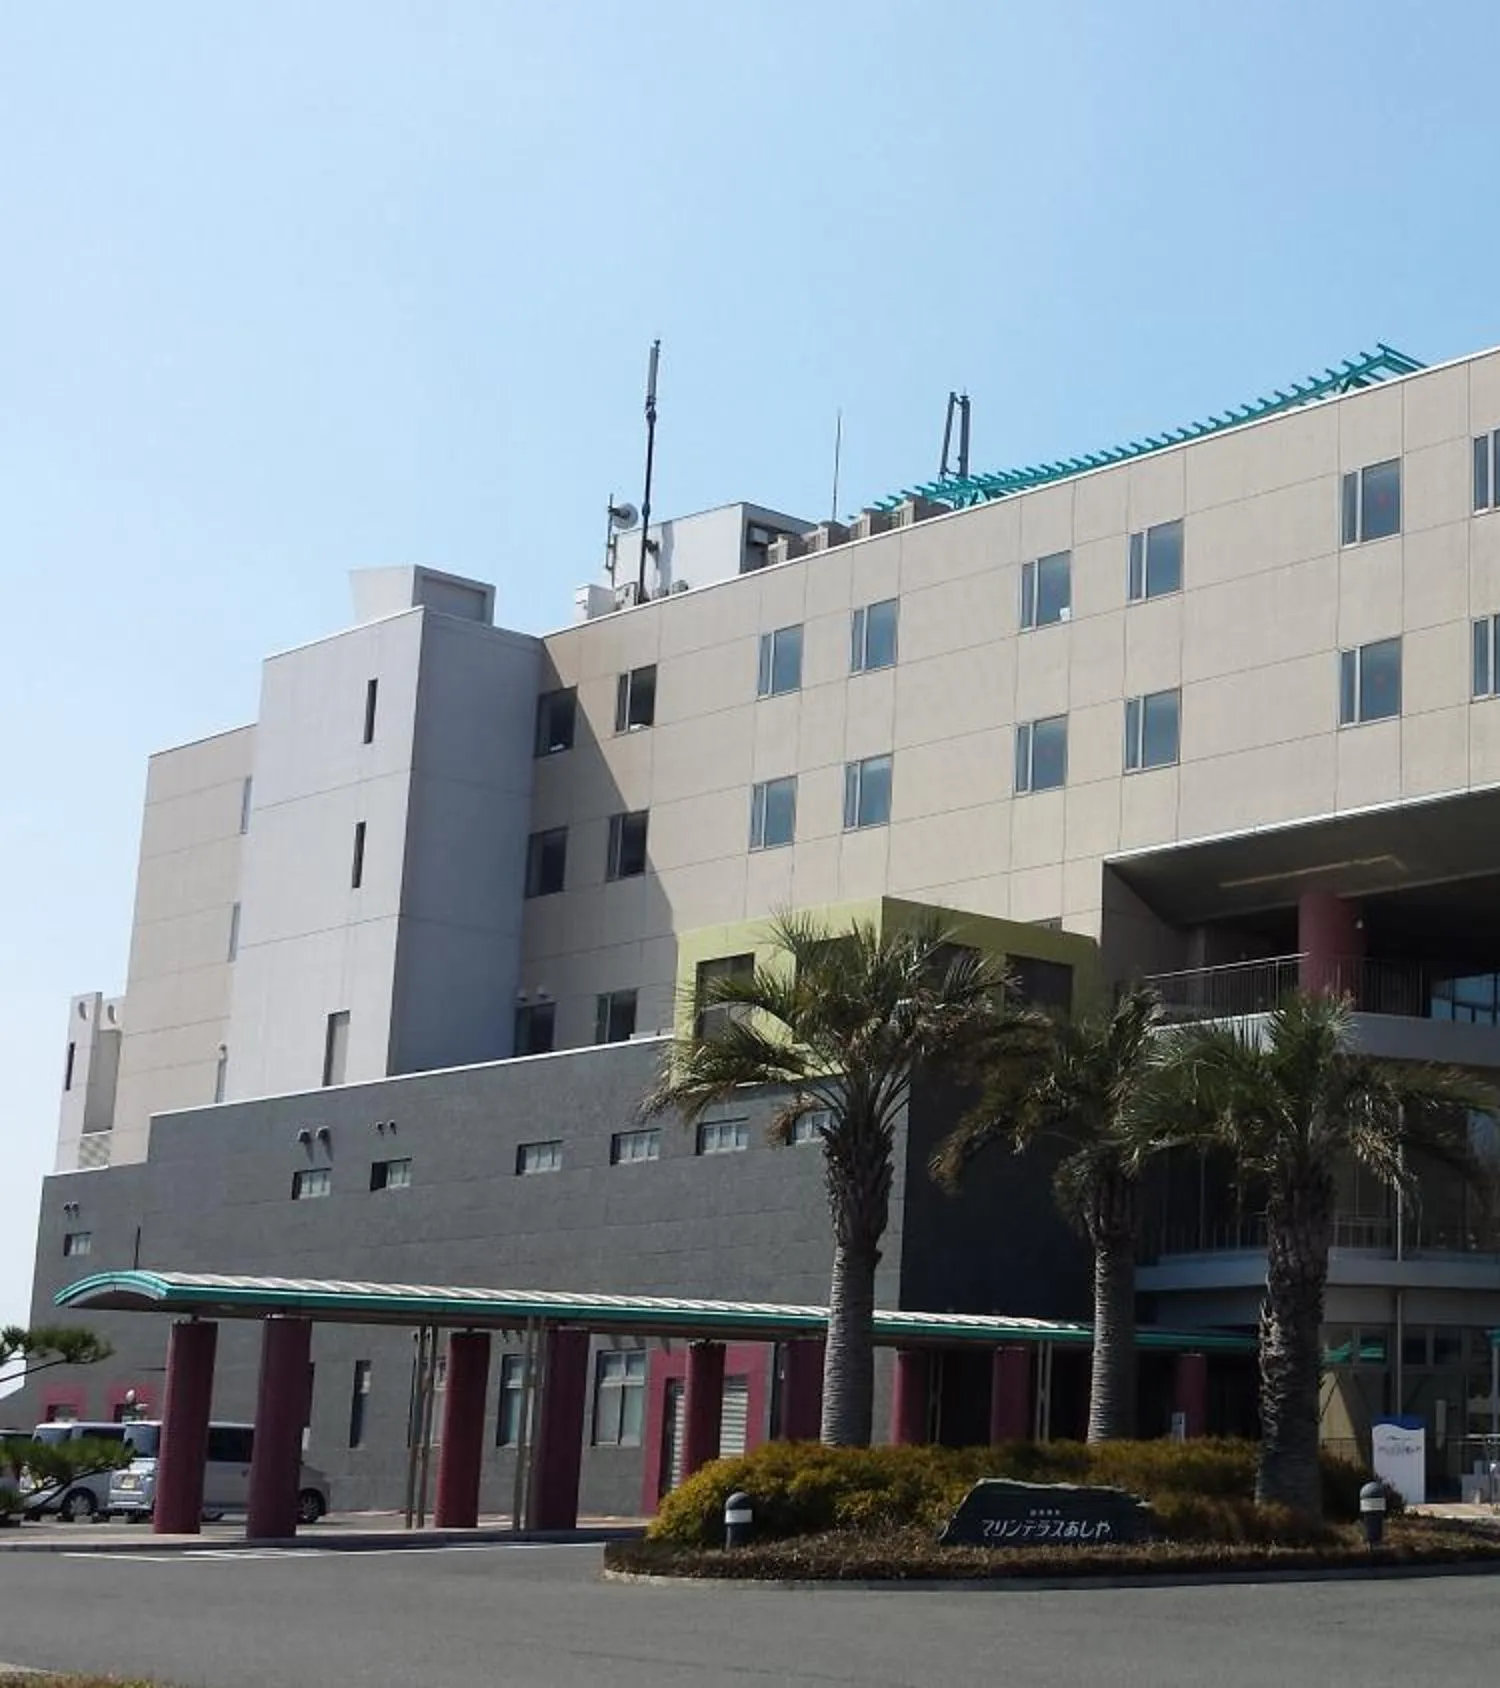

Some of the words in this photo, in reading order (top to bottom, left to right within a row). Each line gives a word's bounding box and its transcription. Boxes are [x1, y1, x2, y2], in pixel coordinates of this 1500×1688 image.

[981, 1519, 1111, 1538] マリンテラスあしや
